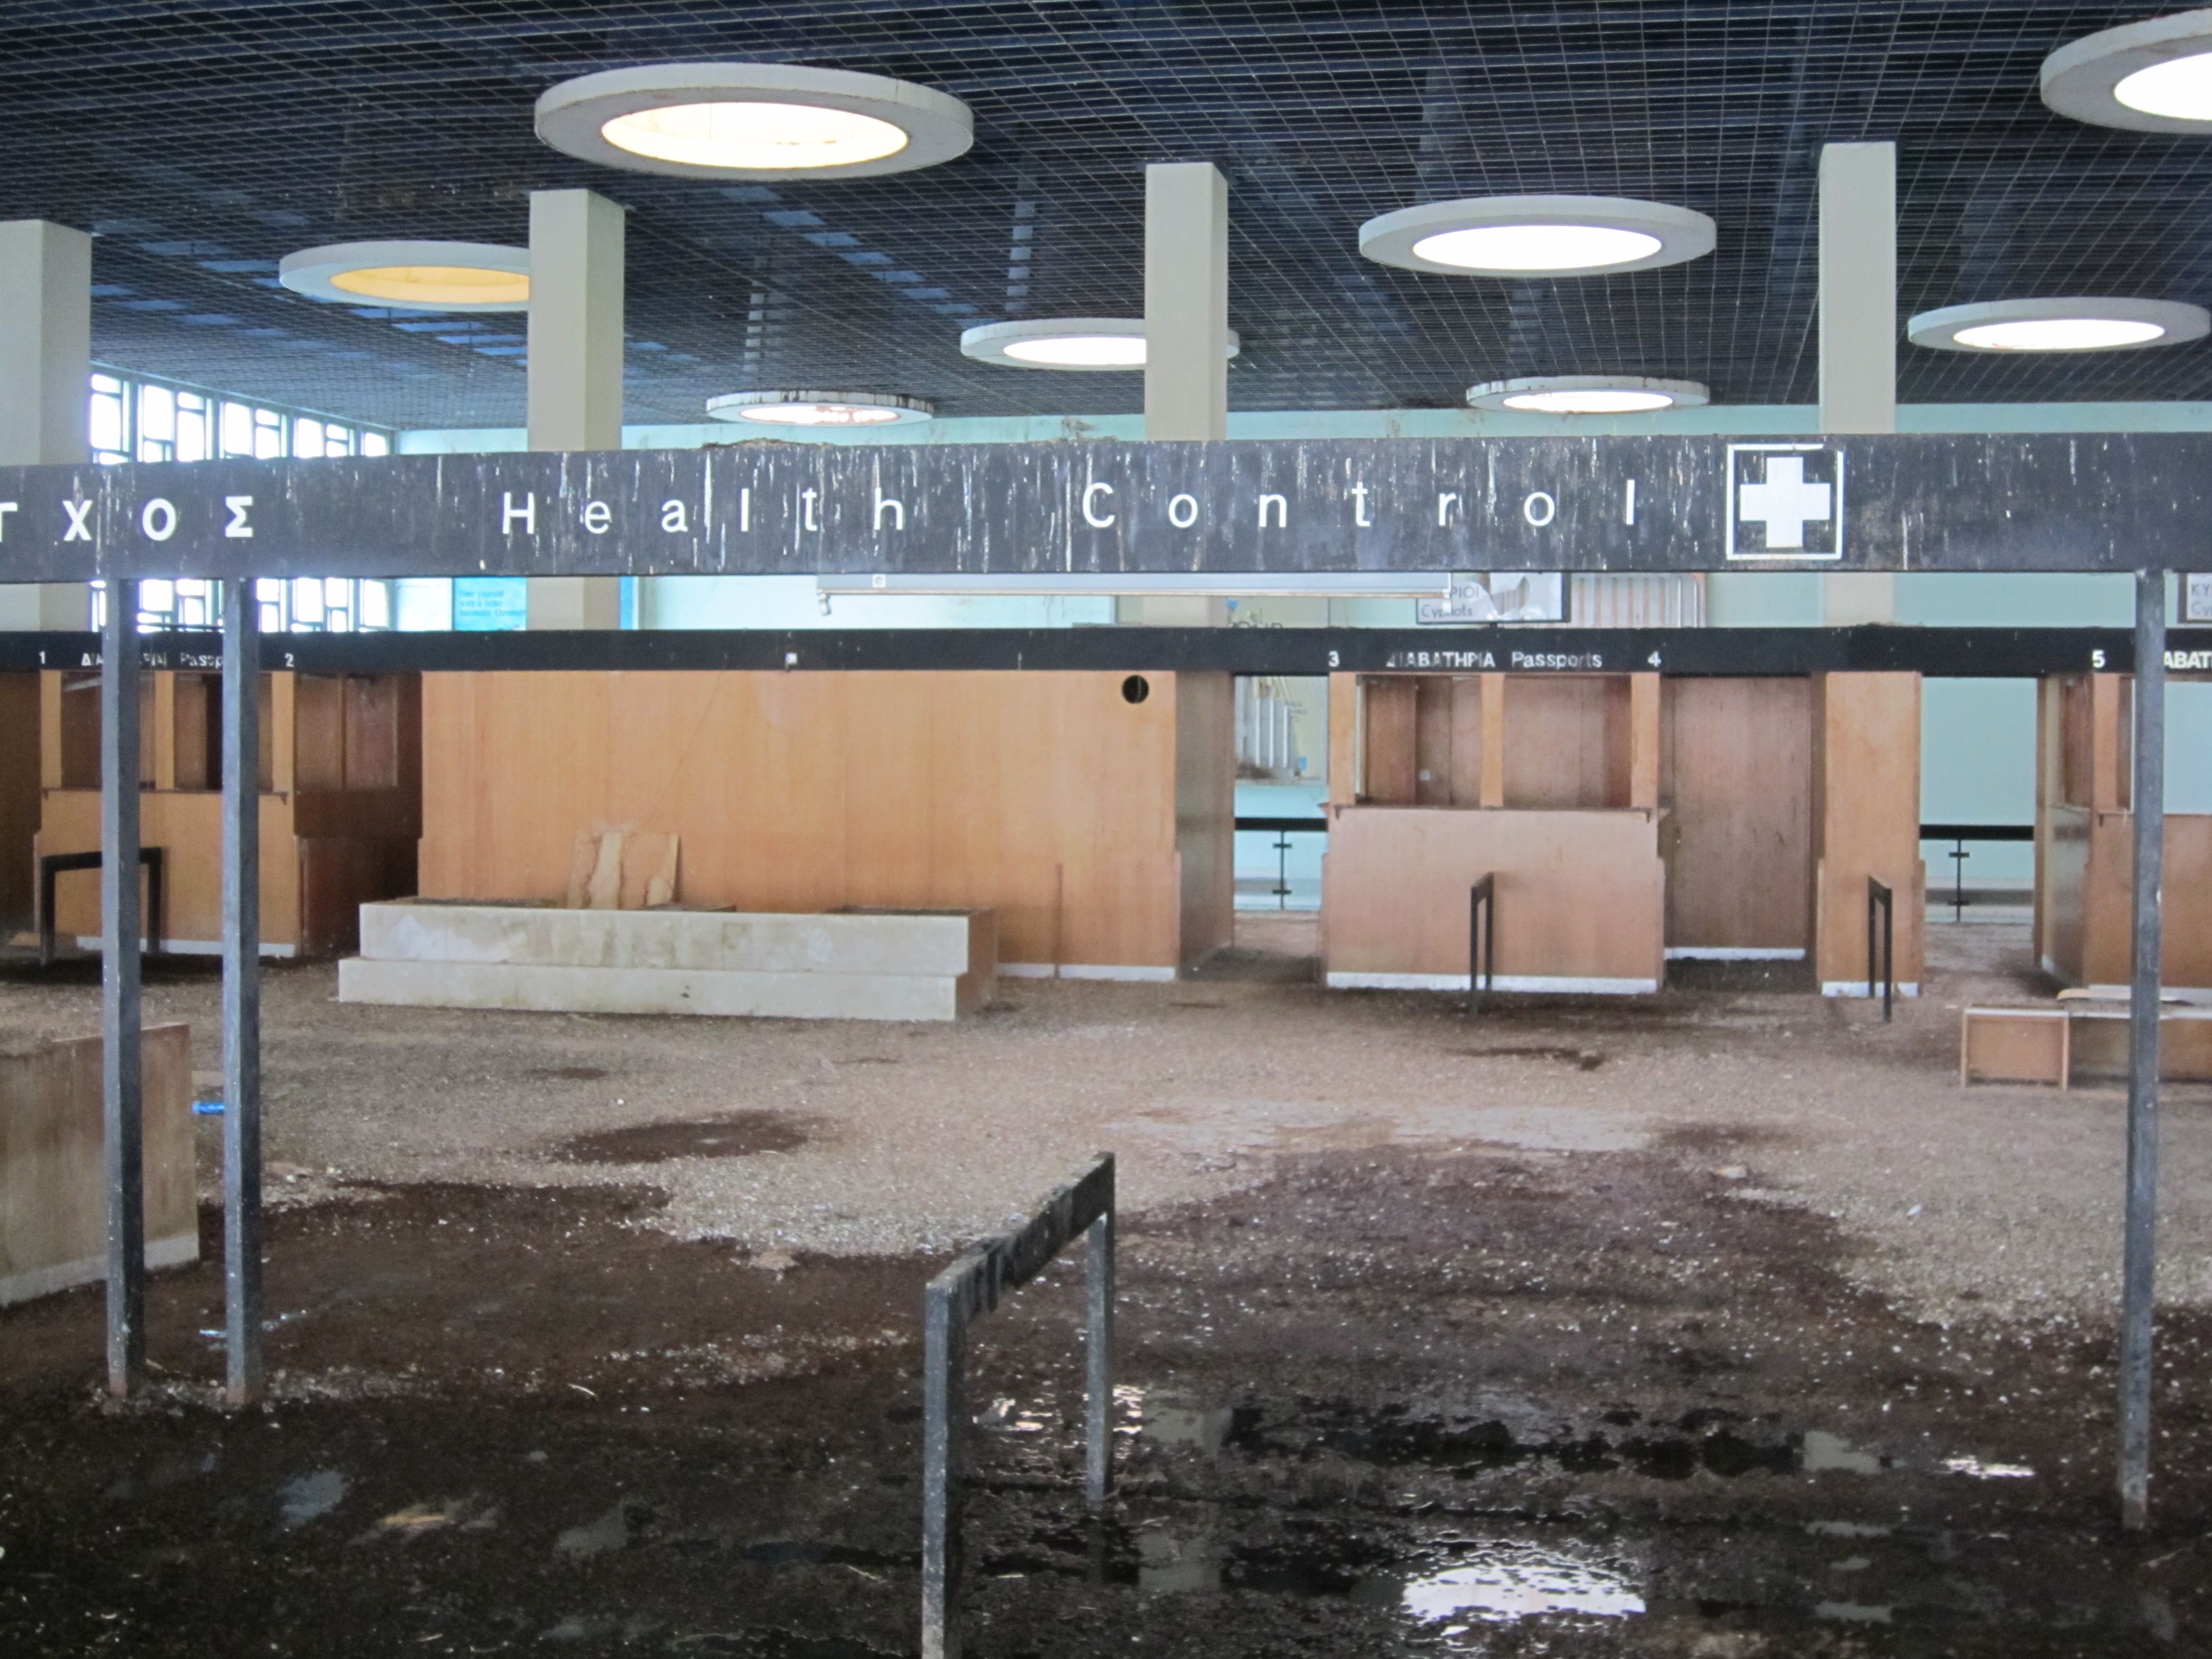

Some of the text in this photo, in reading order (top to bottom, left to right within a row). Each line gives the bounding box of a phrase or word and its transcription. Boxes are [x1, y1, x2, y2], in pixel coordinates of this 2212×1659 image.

[502, 480, 1635, 534] Health Control
[38, 651, 46, 665] 1
[285, 653, 294, 667] 2
[1328, 650, 1339, 667] 3
[1511, 650, 1603, 670] Passports
[1648, 650, 1662, 667] 4
[2092, 650, 2105, 668] 5
